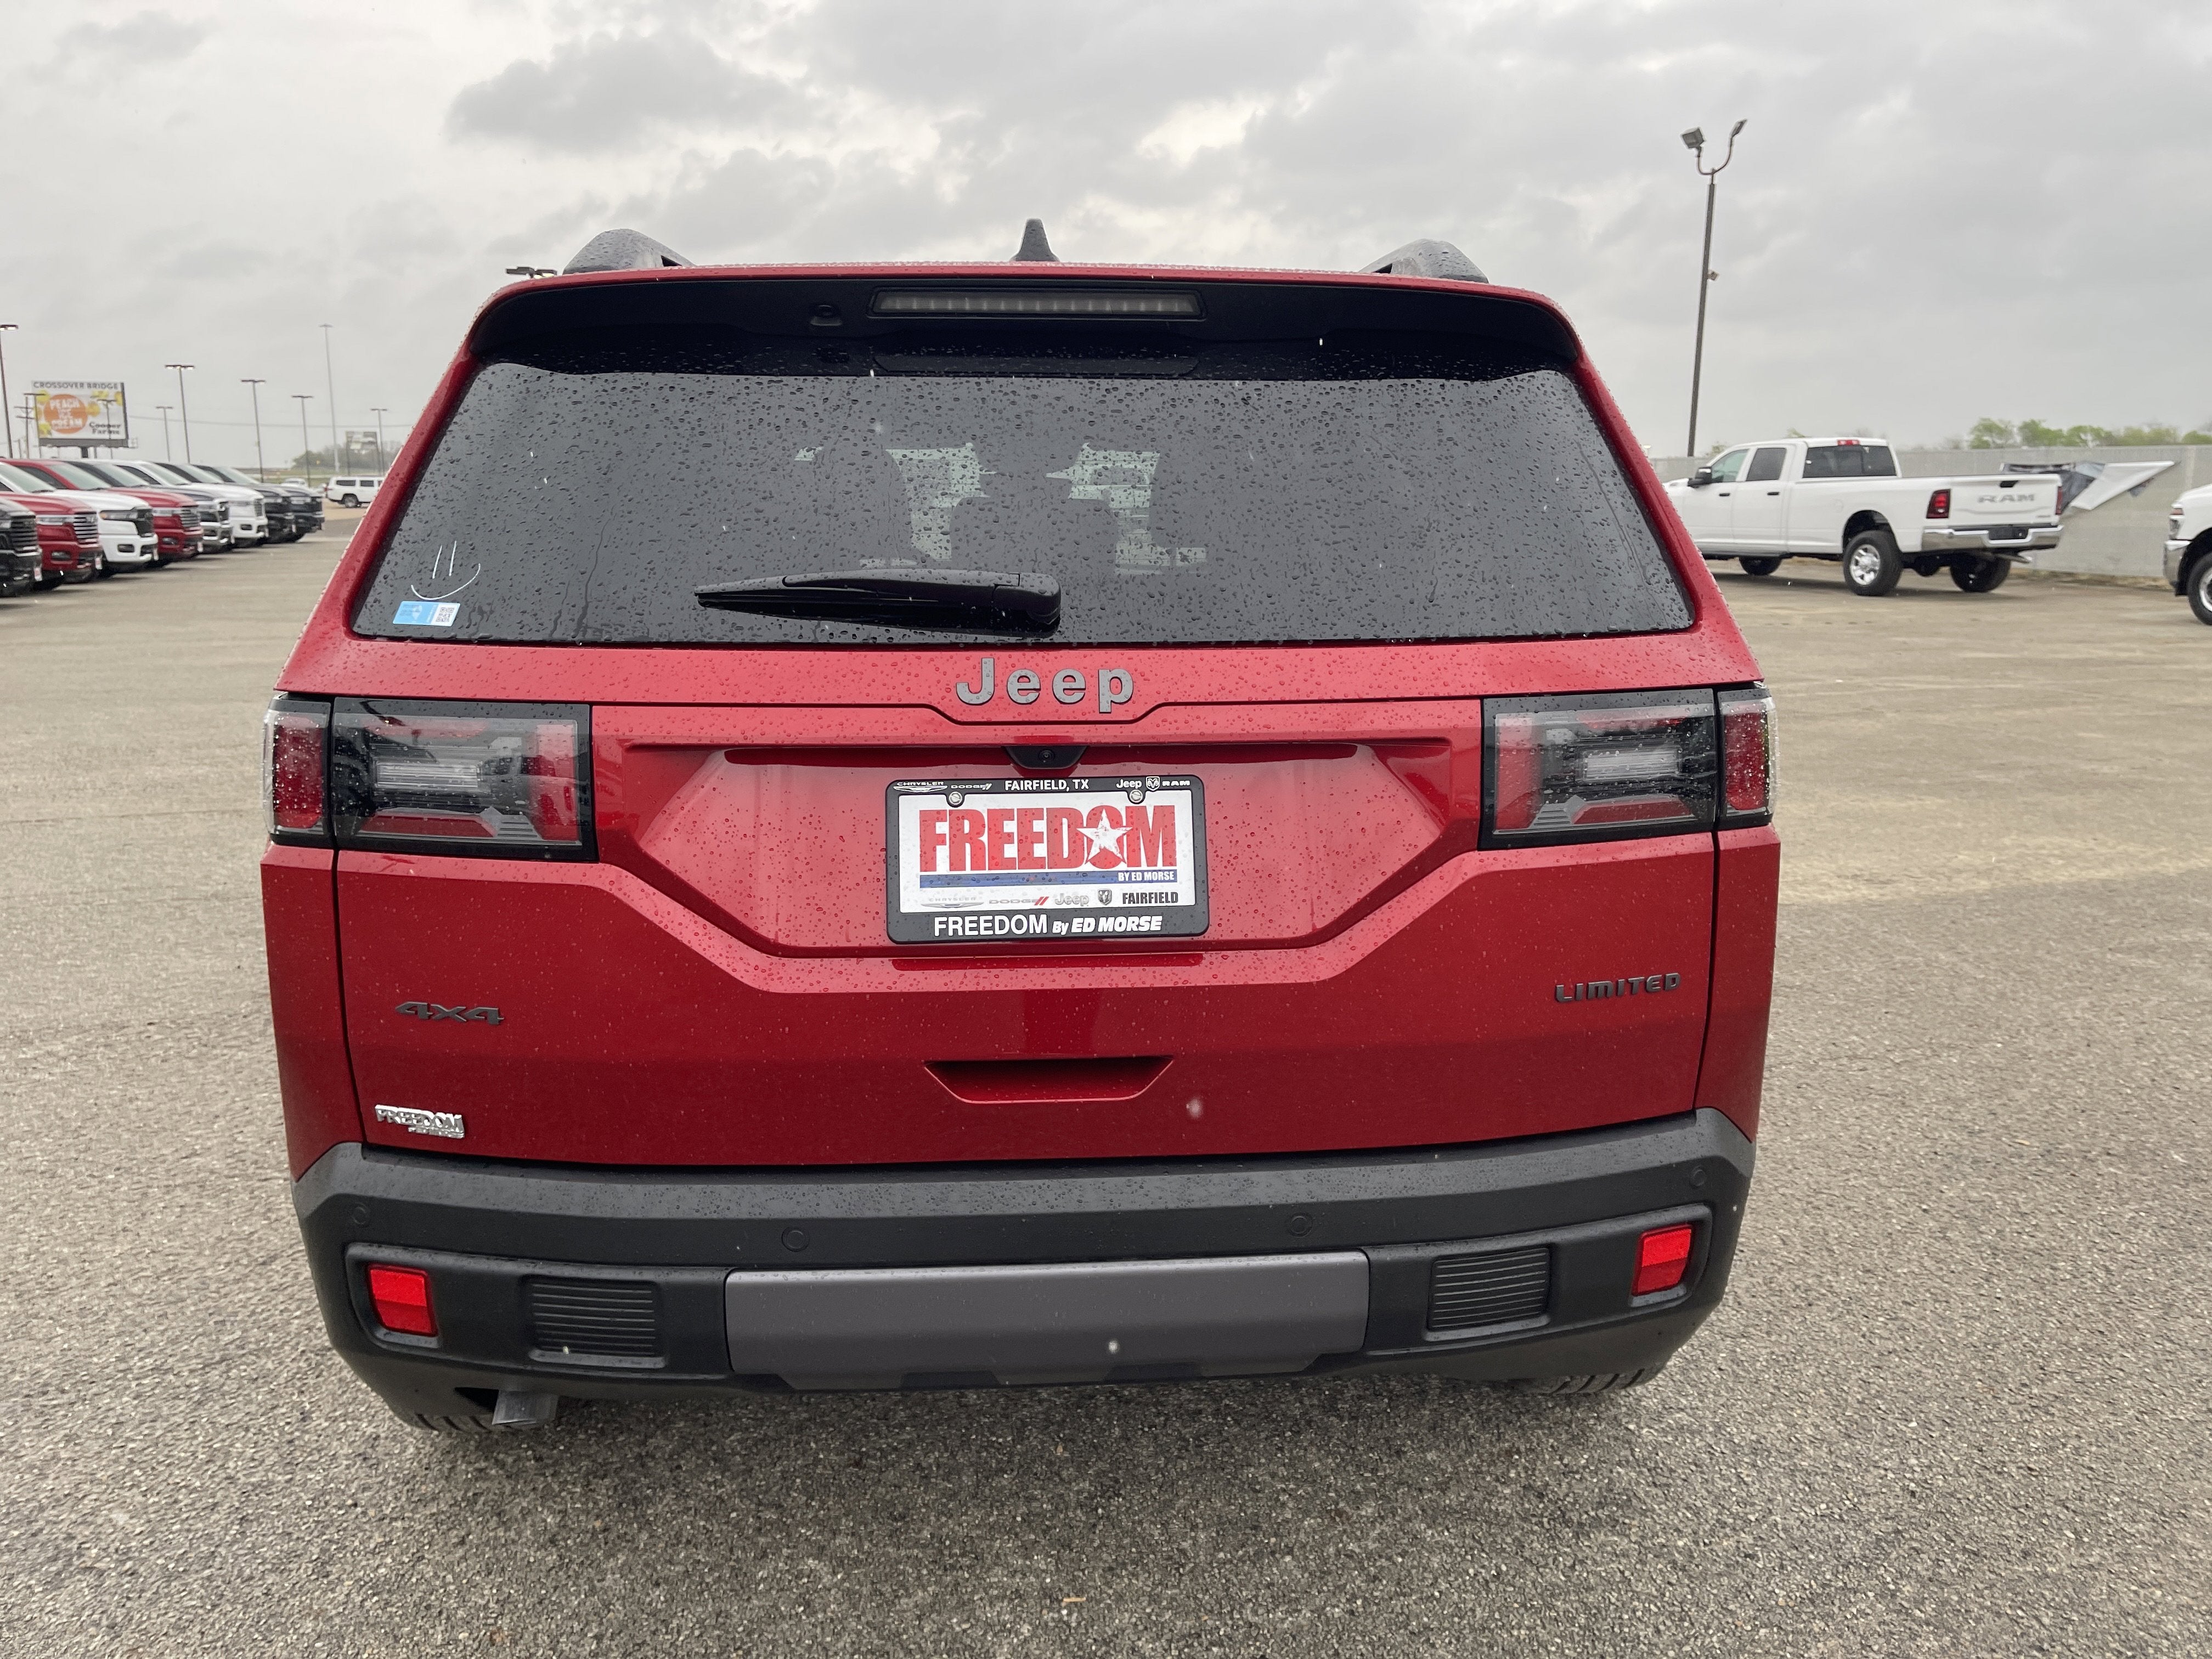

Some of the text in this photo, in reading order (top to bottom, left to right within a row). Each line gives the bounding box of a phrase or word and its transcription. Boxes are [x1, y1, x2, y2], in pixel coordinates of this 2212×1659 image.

[49, 398, 80, 410] PEACH
[51, 419, 82, 430] CREAM
[1978, 494, 2035, 503] RAM
[956, 657, 1134, 714] Jeep
[1005, 779, 1090, 792] FAIRFIELD, TX
[1116, 779, 1142, 789] Jeep
[919, 805, 1177, 872] FREEDOM
[1118, 871, 1175, 882] BY ED MORSE
[1054, 893, 1090, 906] Jeep
[1122, 891, 1178, 905] FAIRFIELD
[934, 913, 1163, 937] FREEDOM By ED MORSE
[1555, 972, 1681, 1003] LIMITED
[375, 1104, 465, 1133] FREEDOM
